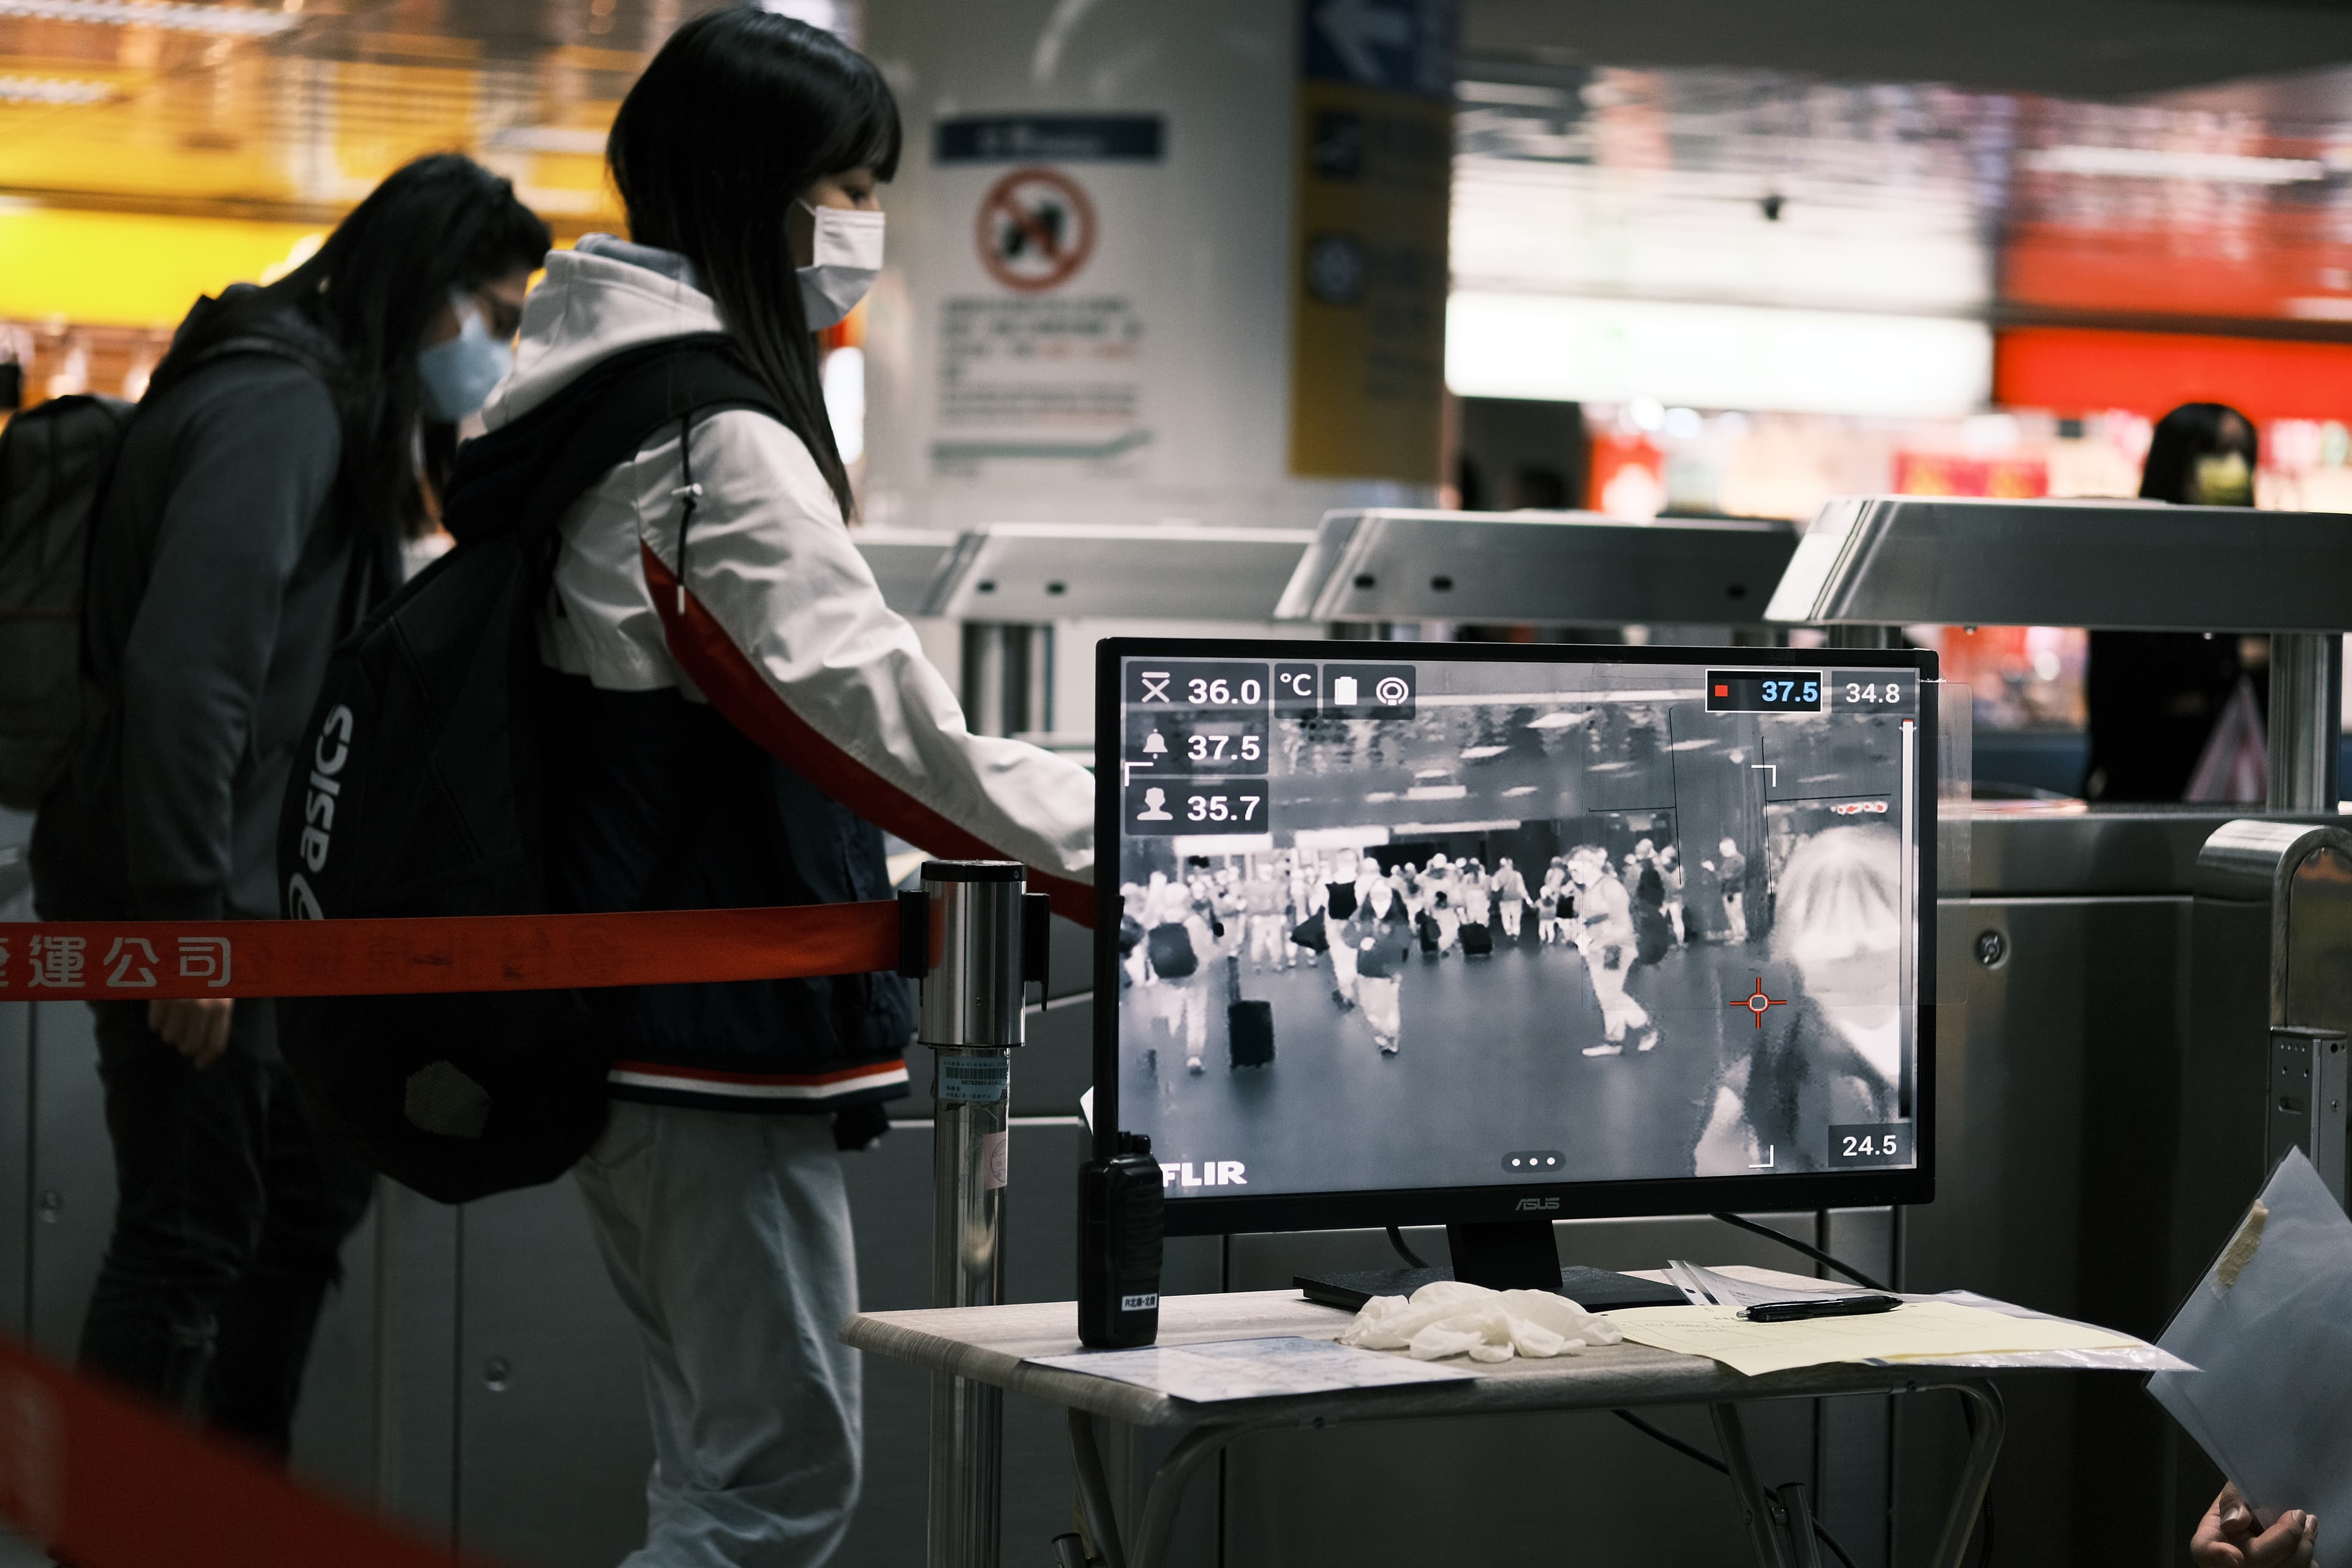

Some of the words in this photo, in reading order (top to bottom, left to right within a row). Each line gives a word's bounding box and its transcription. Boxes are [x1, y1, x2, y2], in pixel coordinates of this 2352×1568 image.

[1188, 679, 1261, 704] 36.0
[1280, 673, 1312, 696] °C
[1762, 680, 1819, 703] 37.5
[1845, 683, 1900, 703] 34.8
[1187, 735, 1261, 761] 37.5
[300, 704, 353, 873] asics
[1187, 796, 1261, 821] 35.7
[0, 934, 232, 988] 運公司
[1842, 1134, 1898, 1156] 24.5
[1159, 1161, 1248, 1187] FLIR
[1515, 1197, 1560, 1211] ASUS
